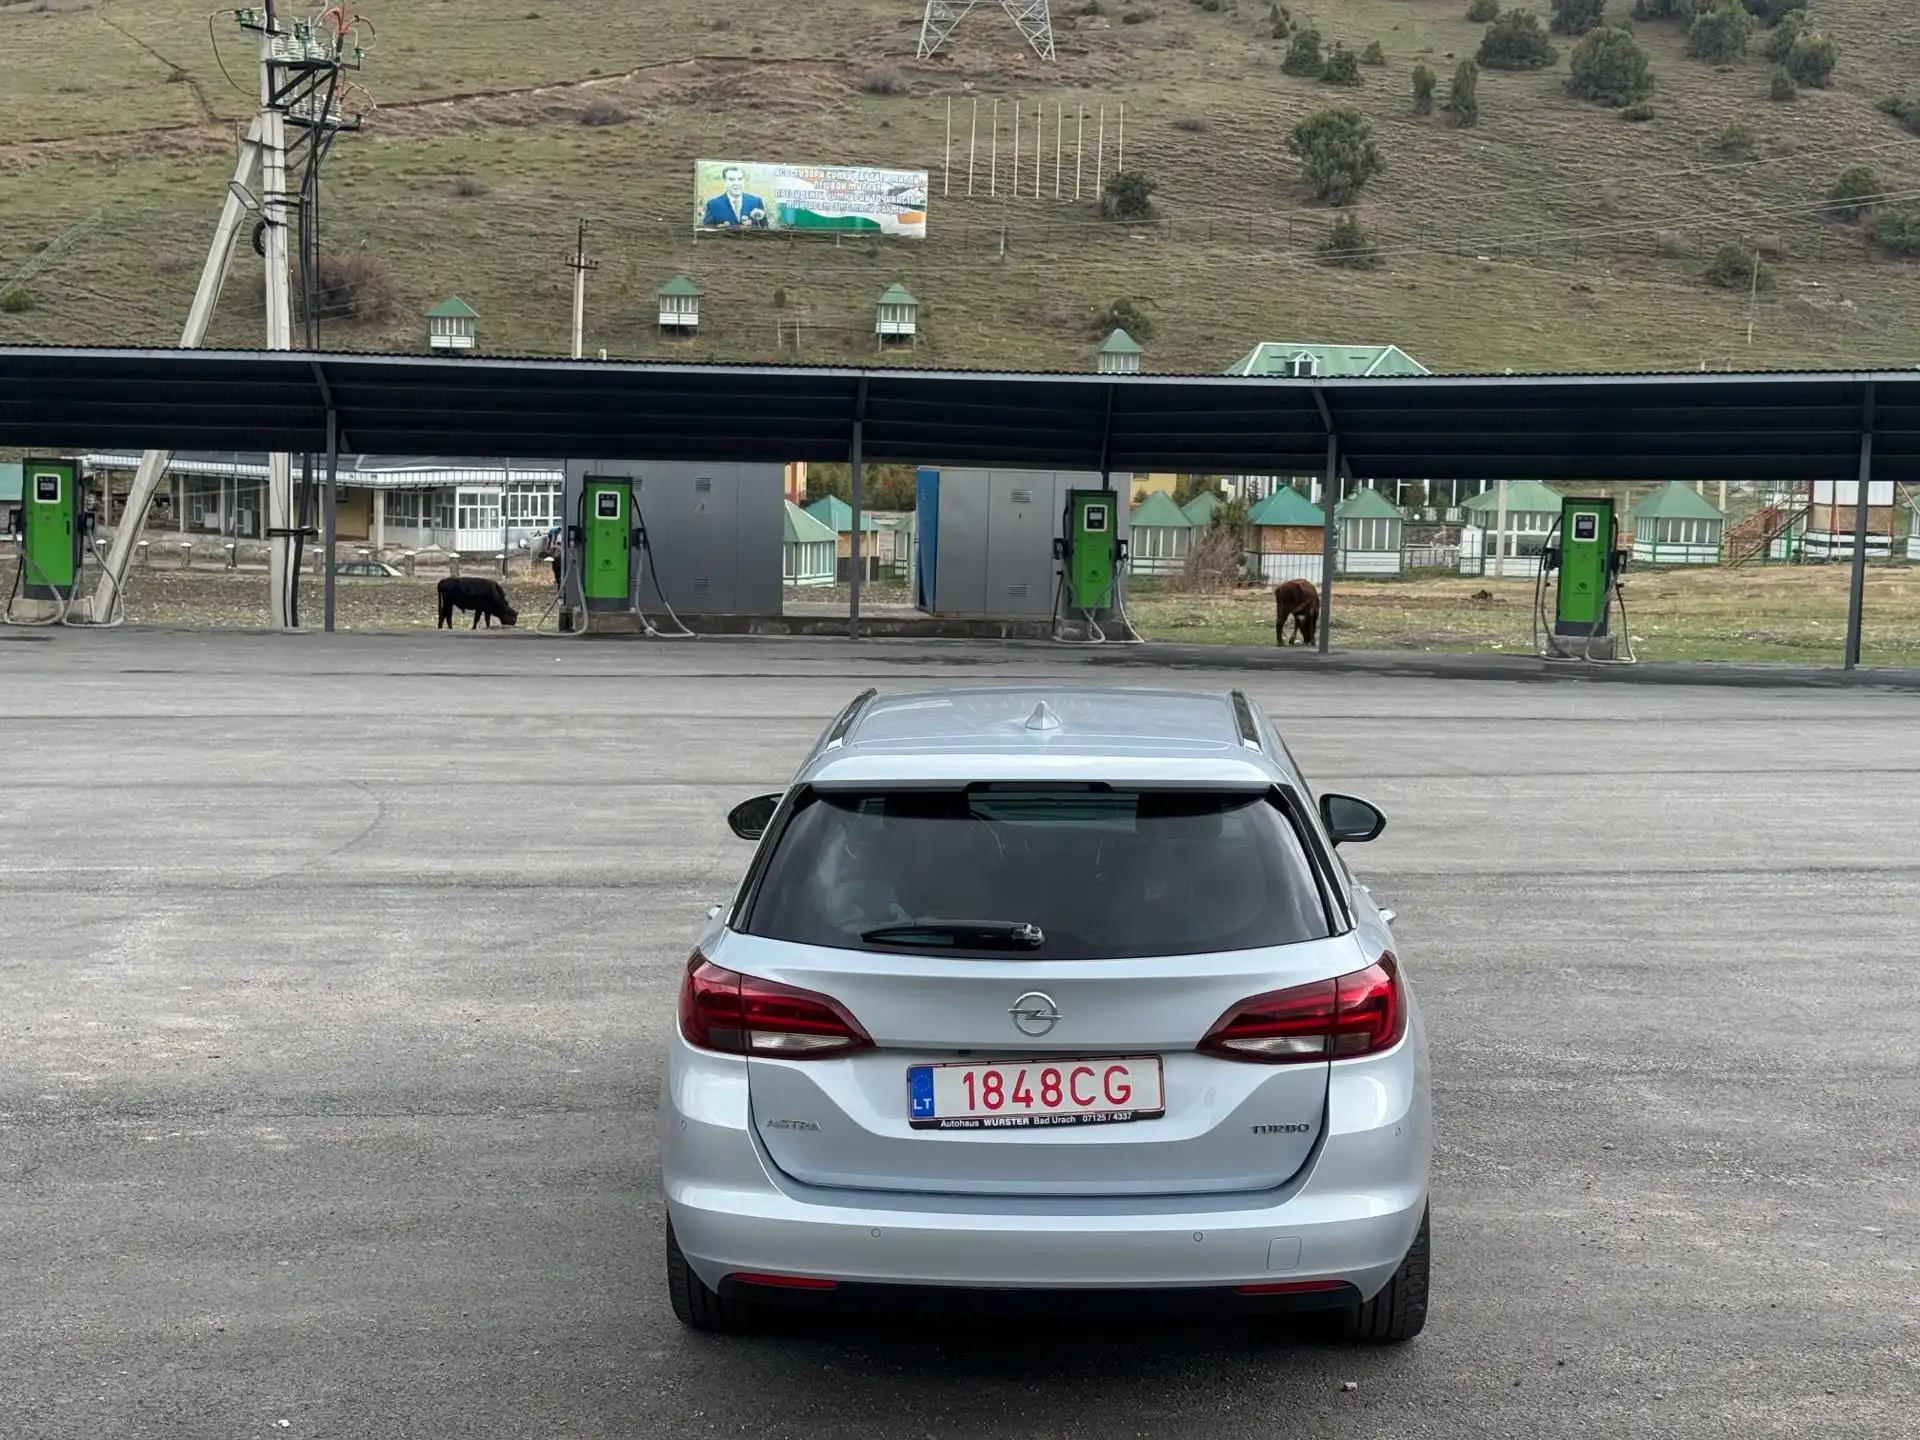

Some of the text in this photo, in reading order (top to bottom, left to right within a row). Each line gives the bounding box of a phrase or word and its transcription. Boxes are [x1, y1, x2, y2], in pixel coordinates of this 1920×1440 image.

[913, 1065, 1132, 1111] LT 1848CG
[767, 1118, 822, 1131] ASTRA
[940, 1119, 979, 1128] Autohaus
[983, 1117, 1029, 1127] WURSTER
[1034, 1116, 1050, 1125] Bad
[1052, 1115, 1076, 1124] Urach
[1082, 1113, 1106, 1122] 07125
[1112, 1112, 1132, 1121] 4337
[1252, 1123, 1310, 1134] TURBO
